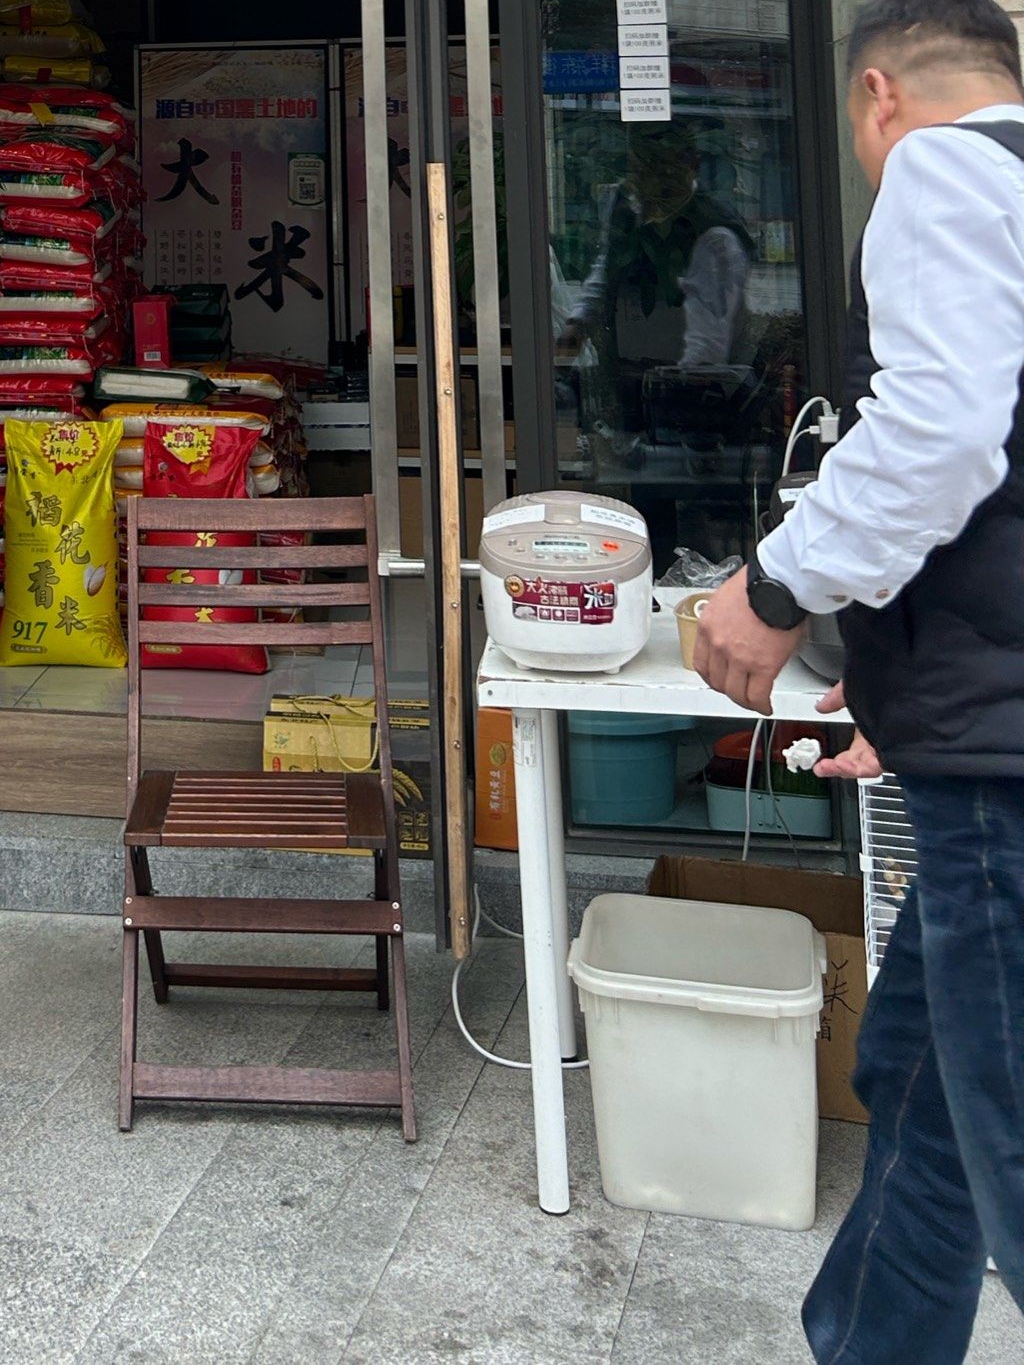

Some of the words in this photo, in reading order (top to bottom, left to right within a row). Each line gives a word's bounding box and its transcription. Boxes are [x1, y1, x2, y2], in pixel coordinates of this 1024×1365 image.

[155, 97, 319, 120] 源自中国黑土地的
[154, 138, 220, 205] 大
[234, 220, 324, 313] 米
[25, 491, 90, 636] 稻花香米
[11, 619, 48, 645] 917
